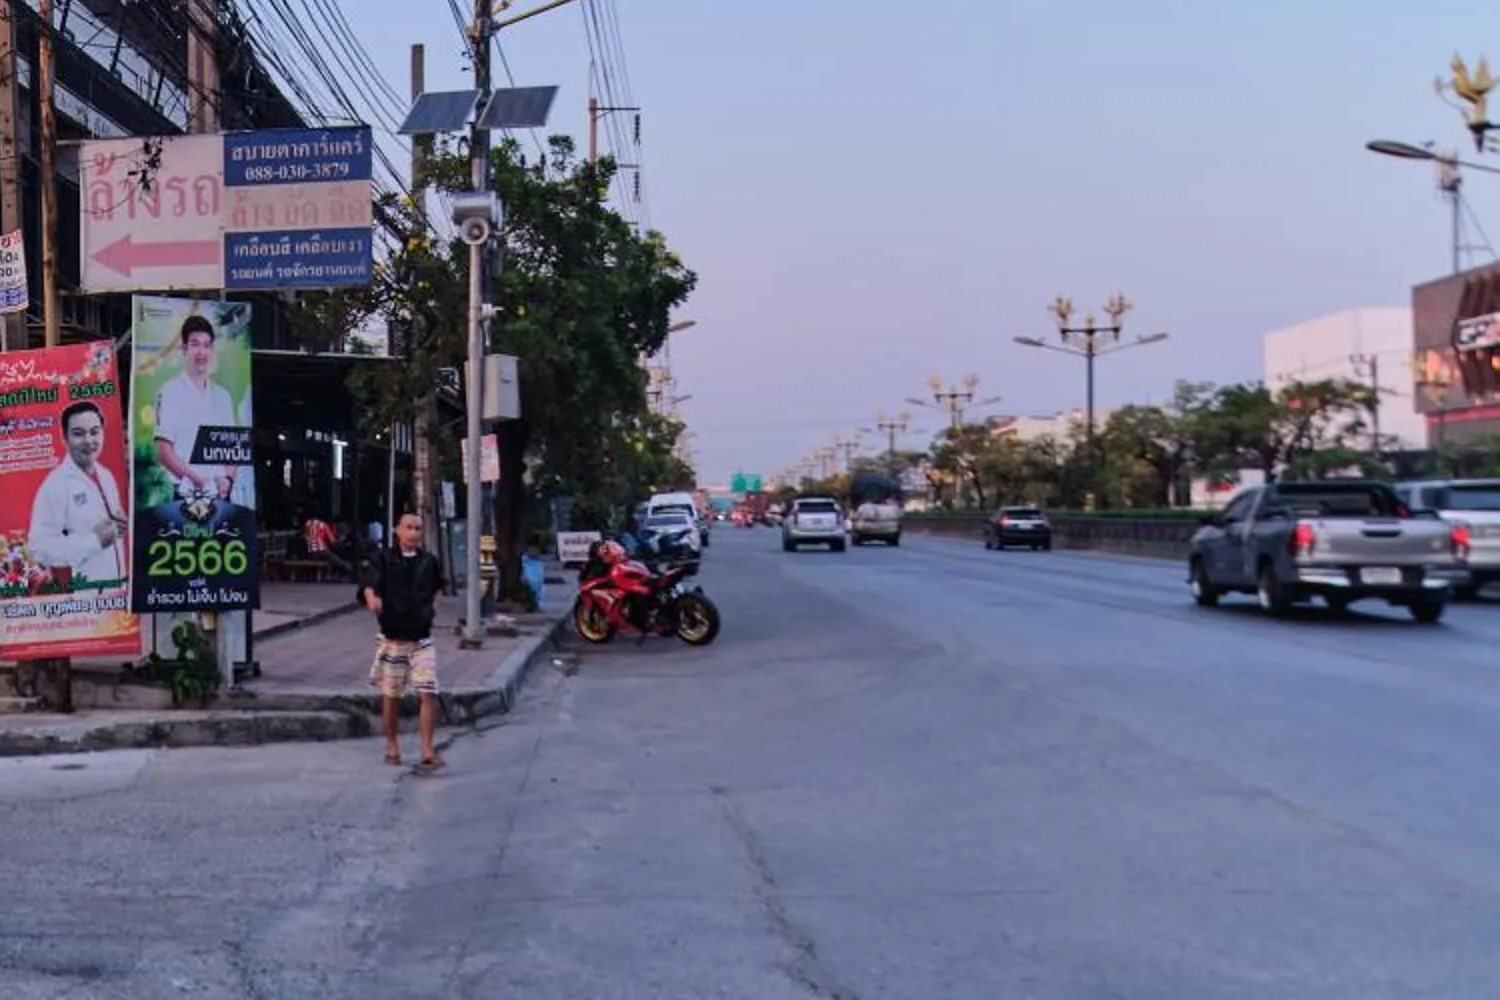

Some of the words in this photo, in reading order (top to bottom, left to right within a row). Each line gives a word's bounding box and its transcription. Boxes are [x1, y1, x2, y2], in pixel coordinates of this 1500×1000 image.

[90, 151, 222, 221] ล้างรถ
[245, 162, 349, 181] 088-030-3879
[148, 539, 248, 577] 2566
